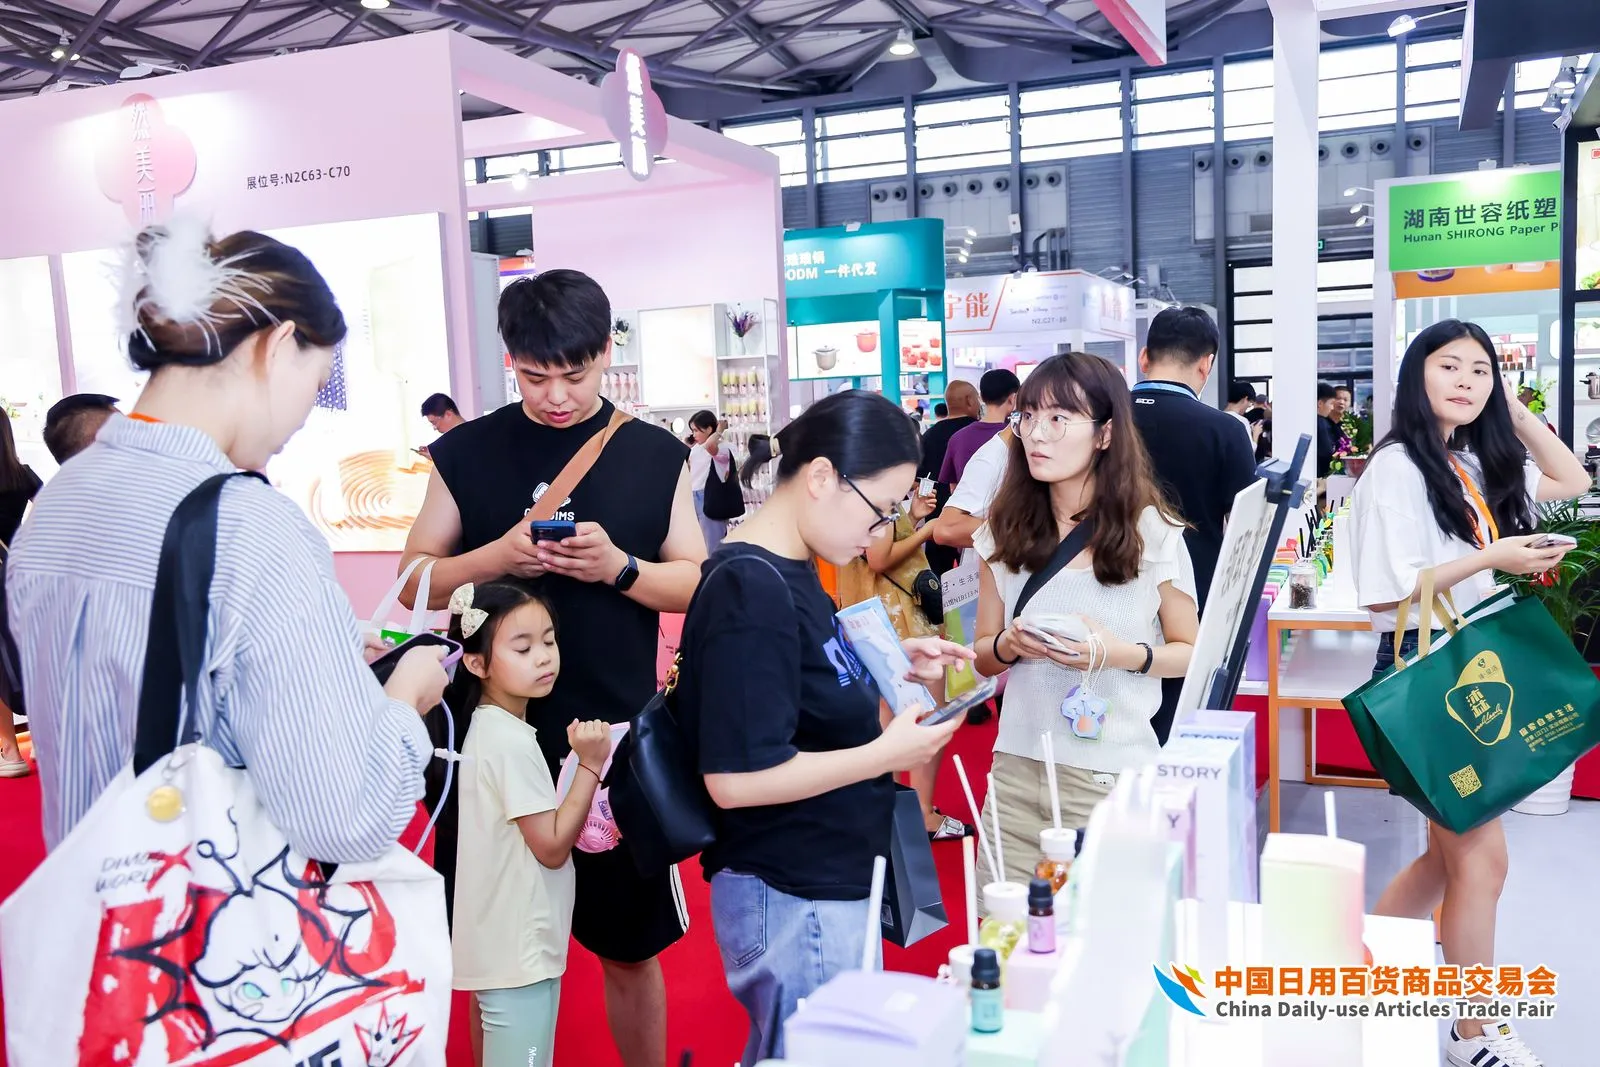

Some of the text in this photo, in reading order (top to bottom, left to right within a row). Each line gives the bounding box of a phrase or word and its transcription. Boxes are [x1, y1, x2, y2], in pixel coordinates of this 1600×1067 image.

[246, 165, 351, 190] 展位号:N2C63-C70
[1403, 197, 1557, 230] 湖南世容纸塑
[1403, 233, 1442, 244] Hunan
[1447, 226, 1505, 241] SHIRONG
[1510, 225, 1546, 237] Paper
[785, 261, 877, 281] ODM 一件代发
[1157, 763, 1222, 780] STORY
